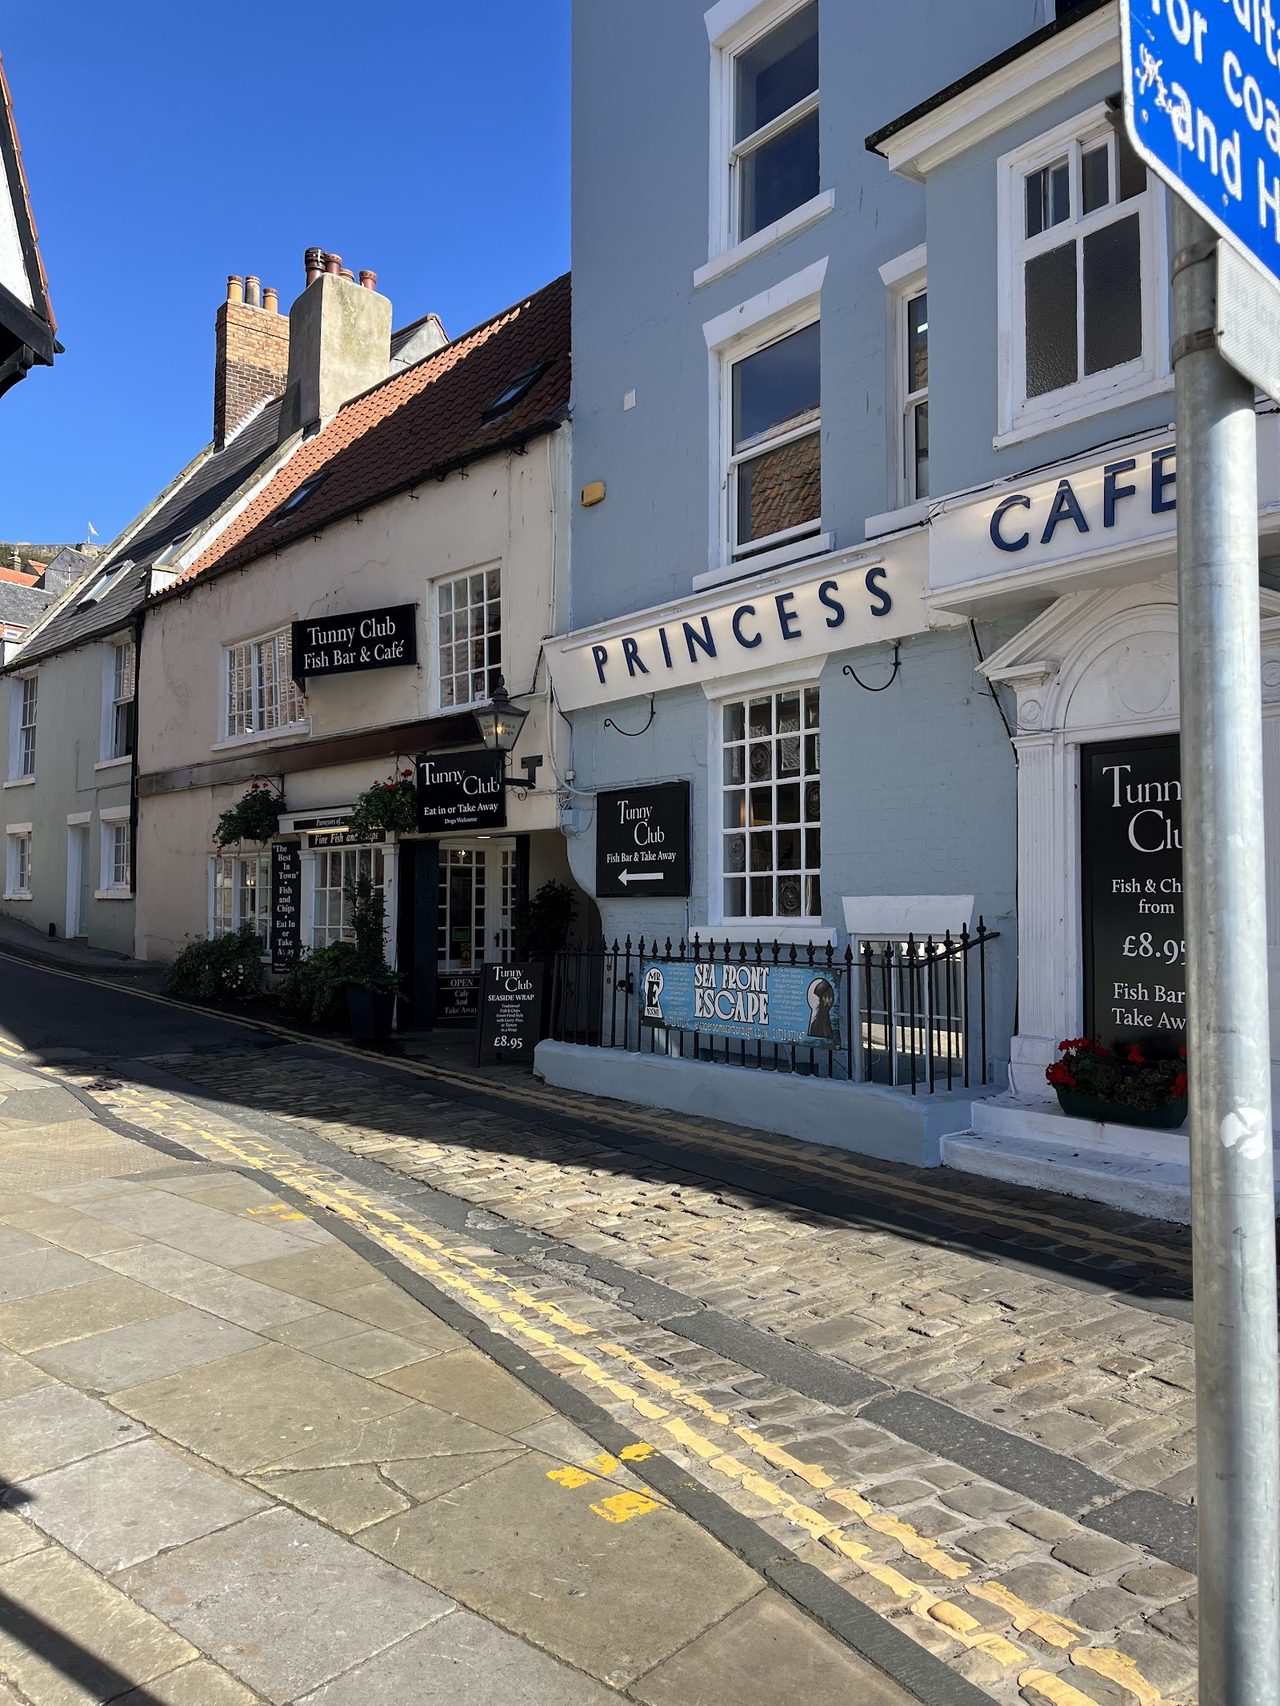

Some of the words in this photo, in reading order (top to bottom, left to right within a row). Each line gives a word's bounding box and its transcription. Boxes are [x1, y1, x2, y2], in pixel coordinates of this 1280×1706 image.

[1152, 0, 1207, 64] or
[1171, 82, 1242, 201] and
[990, 446, 1176, 552] CAFE
[307, 627, 355, 647] Tunny
[360, 615, 396, 639] Club
[592, 567, 892, 684] PRINCESS
[304, 651, 330, 669] Fish
[333, 649, 356, 666] Bar
[360, 646, 371, 663] &
[374, 639, 405, 661] Café
[419, 762, 465, 786] Tunny
[463, 775, 500, 795] Club
[1102, 765, 1183, 808] Tunn
[424, 807, 437, 816] Eat
[438, 805, 446, 815] in
[447, 806, 456, 814] or
[457, 803, 476, 813] Take
[477, 802, 498, 813] Away
[617, 800, 653, 824] Tunny
[314, 834, 328, 845] Fine
[330, 832, 344, 843] Fish
[634, 821, 665, 846] Club
[1128, 808, 1184, 853] Clu
[278, 853, 291, 862] Best
[606, 852, 620, 864] Fish
[621, 852, 633, 863] Bar
[633, 851, 639, 862] &
[640, 850, 657, 861] Take
[657, 850, 677, 863] Away
[283, 862, 291, 870] In
[279, 886, 293, 894] Fish
[1111, 878, 1141, 893] Fish
[1144, 878, 1157, 893] &
[278, 896, 291, 904] and
[1138, 898, 1176, 914] from
[276, 904, 295, 914] Chips
[276, 920, 287, 928] Eat
[288, 920, 296, 928] In
[277, 938, 293, 946] Take
[492, 966, 524, 981] Tunny
[694, 963, 716, 988] SEA
[722, 964, 769, 992] FRONT
[450, 978, 474, 987] OPEN
[505, 977, 533, 992] Club
[488, 994, 514, 1002] SEASIDE
[647, 981, 660, 1008] E
[1113, 982, 1149, 1001] Fish
[1154, 985, 1186, 1003] Bar
[444, 1007, 460, 1015] Take
[462, 1006, 477, 1014] Away
[694, 988, 769, 1025] ESCAPE
[1111, 1007, 1153, 1027] Take
[1157, 1011, 1187, 1030] Aw
[493, 1035, 523, 1050] £8.95
